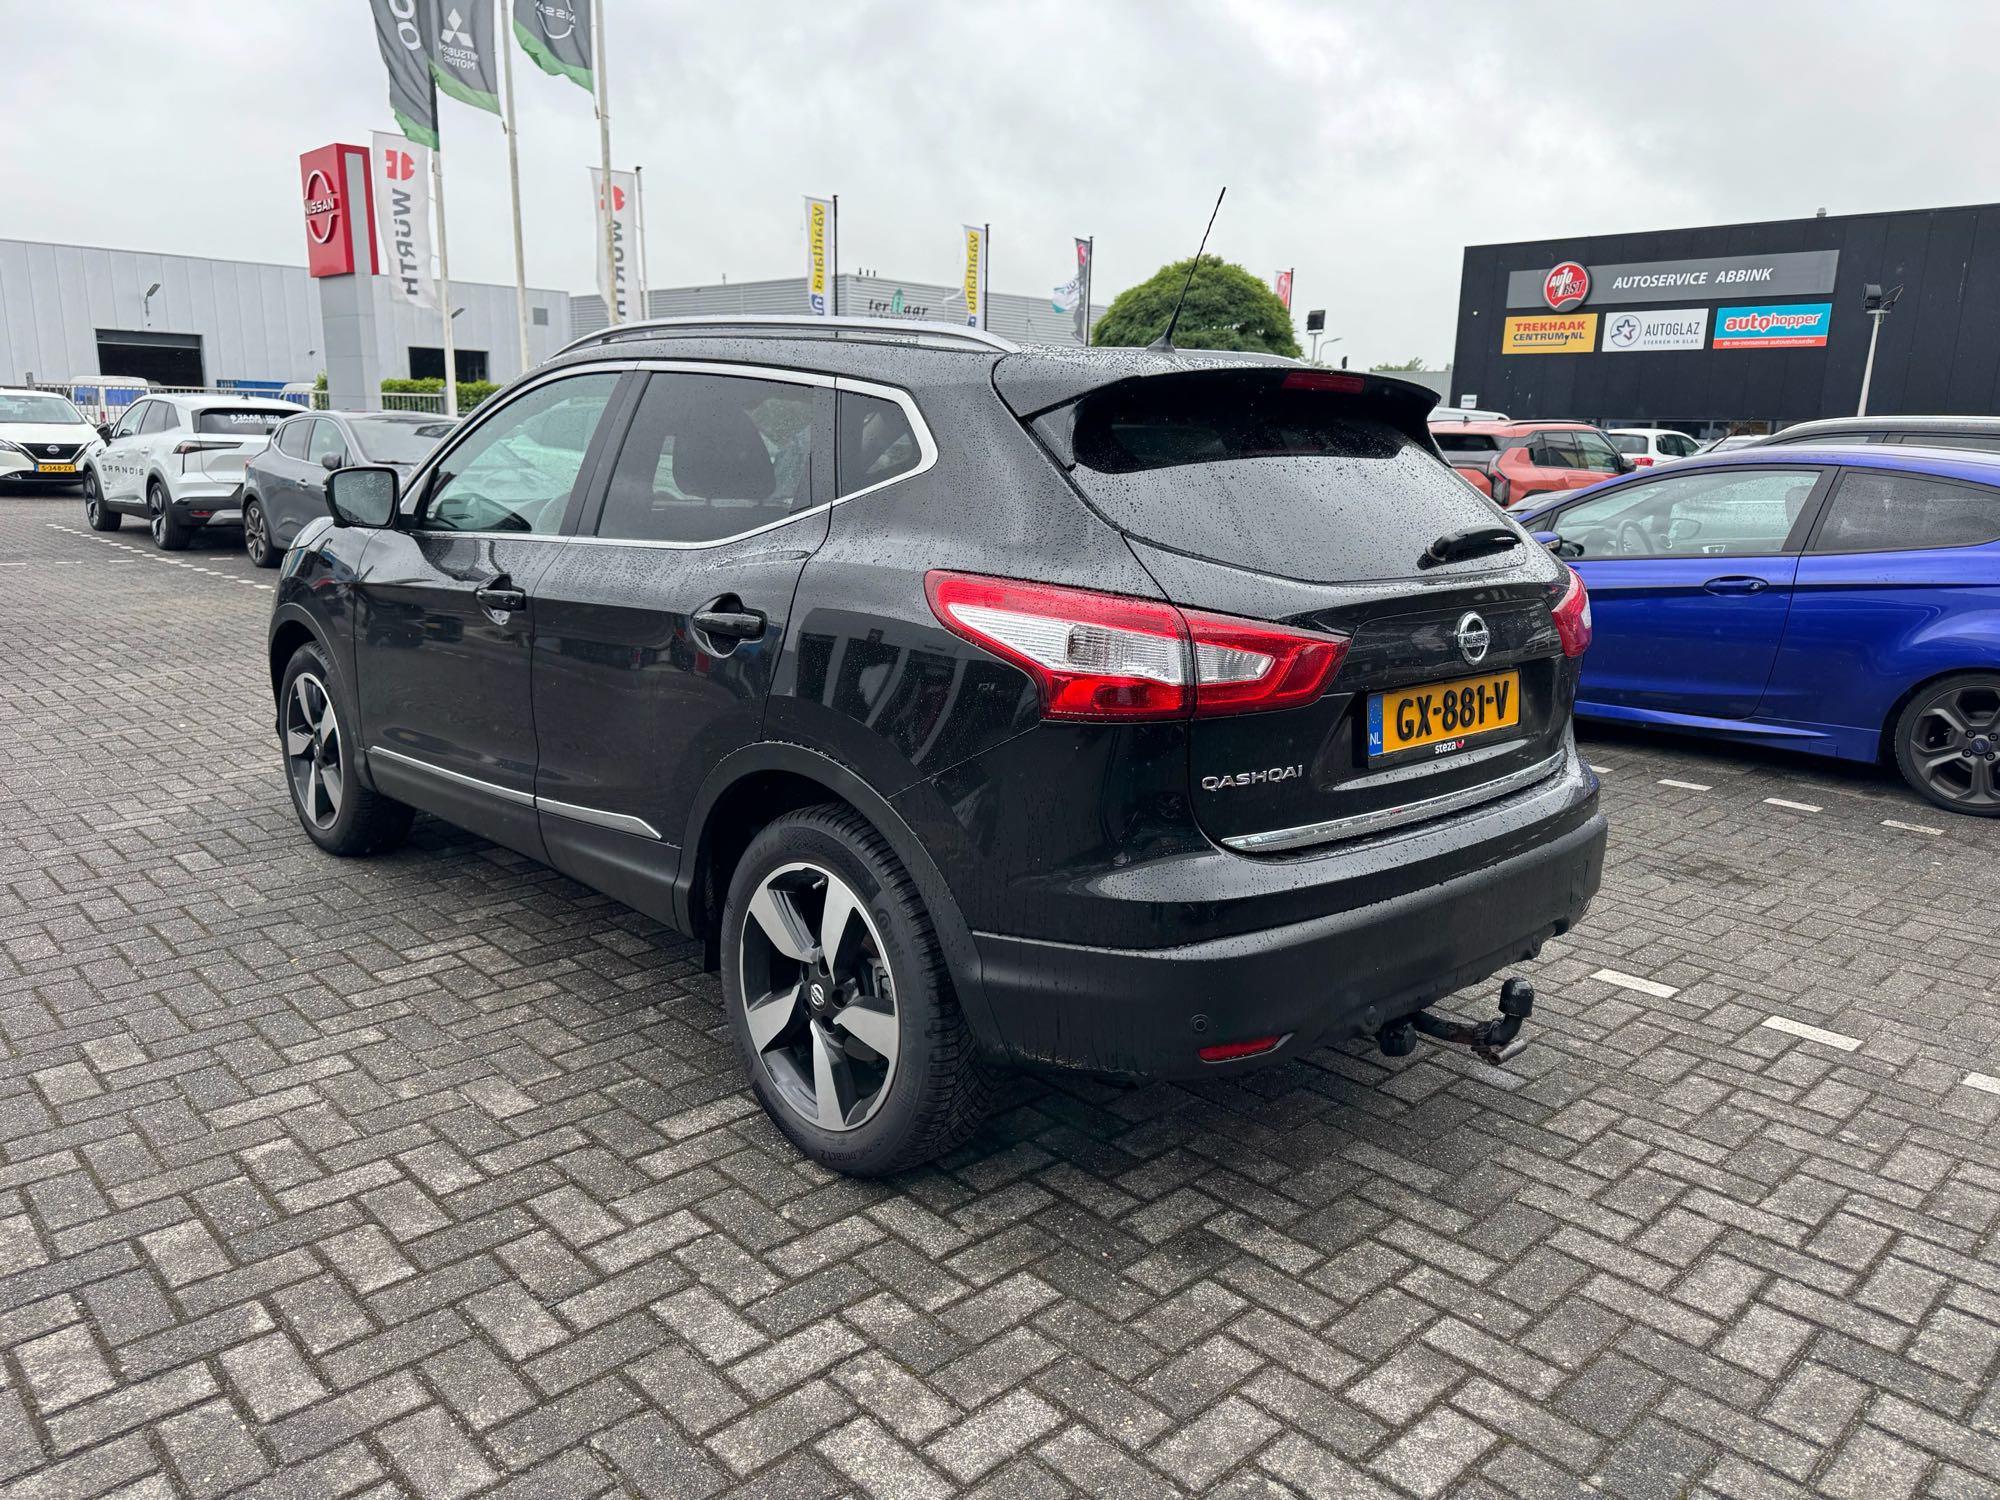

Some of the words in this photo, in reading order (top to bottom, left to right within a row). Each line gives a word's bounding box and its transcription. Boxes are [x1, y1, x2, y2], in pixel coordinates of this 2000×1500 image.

[304, 197, 335, 215] NISSAN
[1612, 272, 1709, 289] AUTOSERVICE
[1715, 267, 1774, 284] ABBINK
[1515, 320, 1586, 333] TREKHAAK
[1644, 321, 1700, 337] AUTOGLAZ
[1725, 313, 1821, 332] autohopper
[102, 465, 144, 476] GRANDIS
[1397, 680, 1510, 741] GX-881-V
[1369, 733, 1382, 746] NL
[1434, 741, 1457, 755] steza
[1201, 764, 1303, 792] QASHQAI
